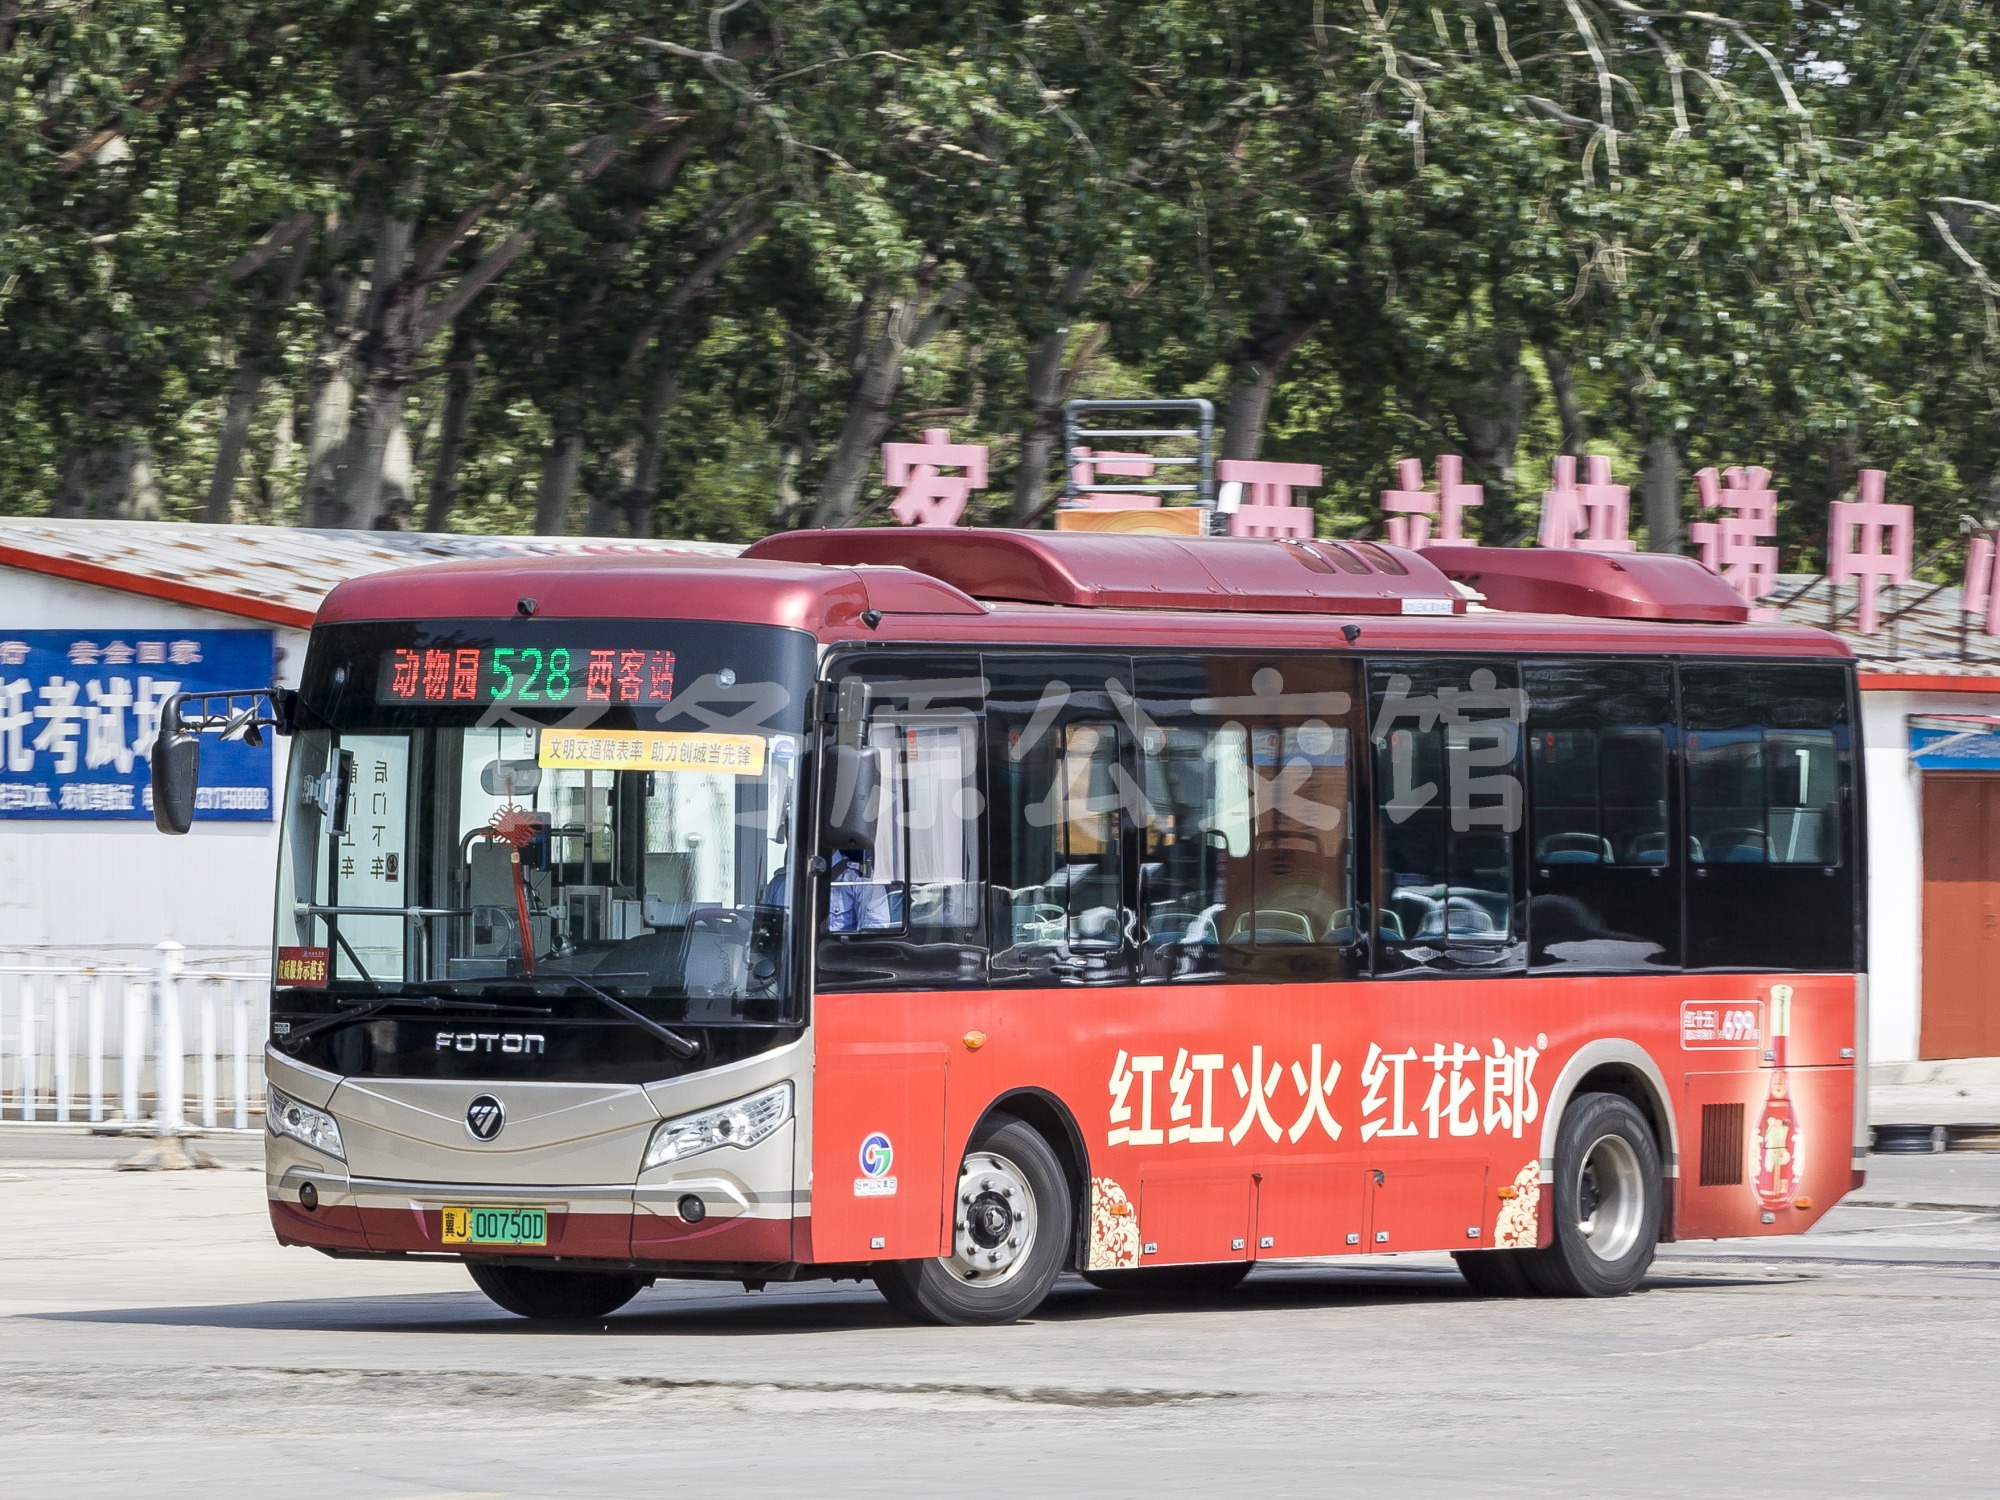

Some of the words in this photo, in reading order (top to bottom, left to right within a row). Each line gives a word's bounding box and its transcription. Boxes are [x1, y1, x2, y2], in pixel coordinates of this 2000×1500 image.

[392, 648, 480, 700] 动物园
[490, 647, 570, 701] 528
[586, 649, 676, 701] 西客站
[548, 737, 643, 761] 文明交通做表率
[650, 741, 752, 766] 助力创城当先锋
[1723, 1010, 1756, 1041] 699
[435, 1032, 545, 1054] FOTON
[1107, 1043, 1343, 1147] 红红火火
[1360, 1037, 1541, 1144] 红花郎
